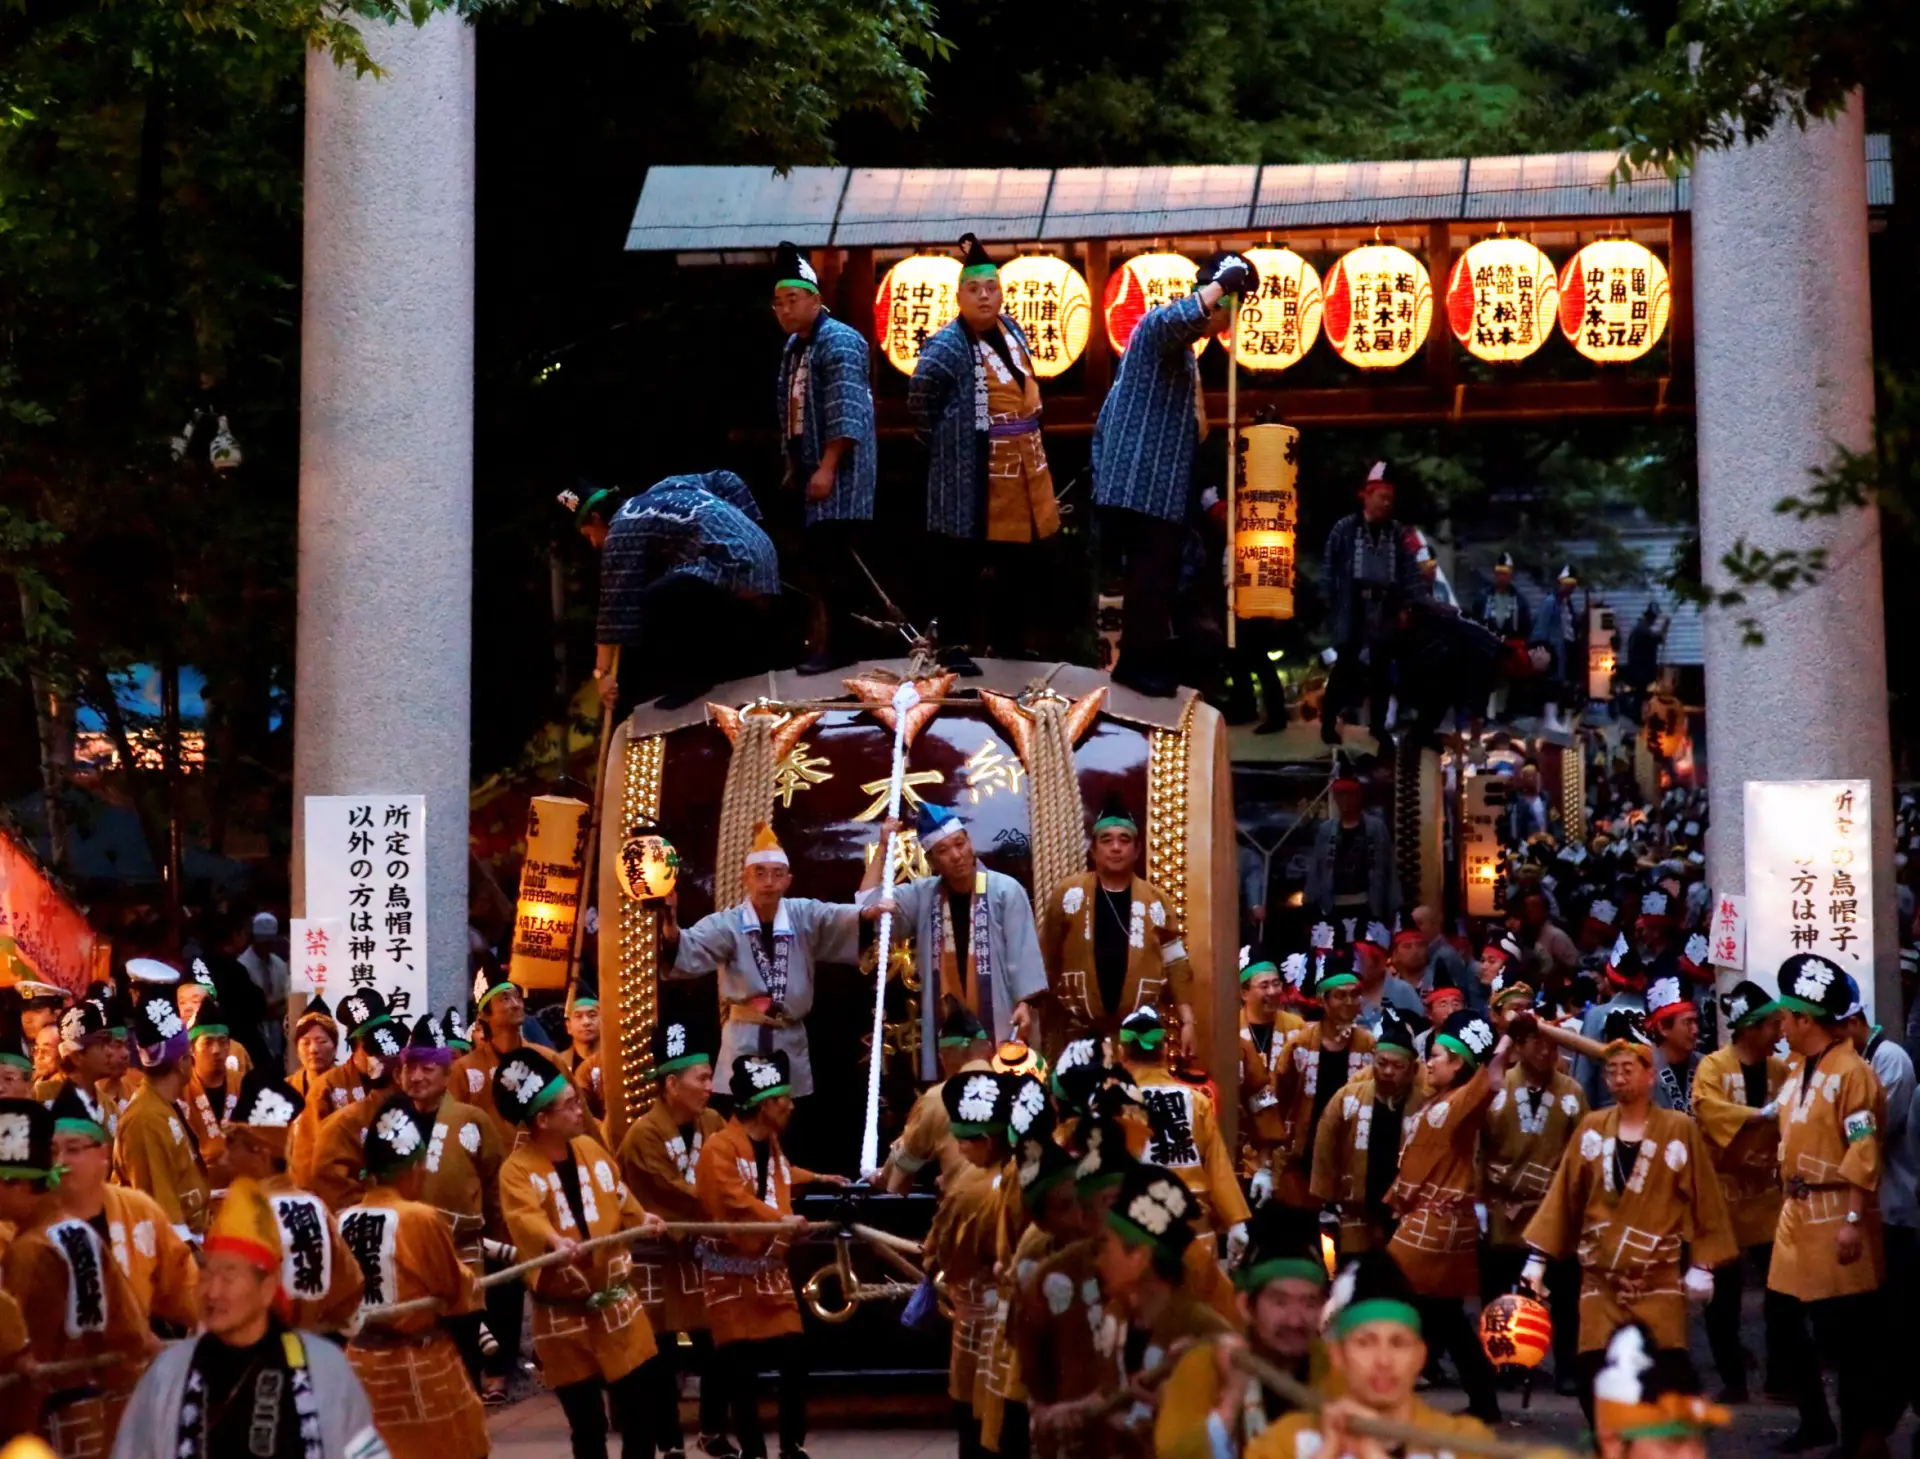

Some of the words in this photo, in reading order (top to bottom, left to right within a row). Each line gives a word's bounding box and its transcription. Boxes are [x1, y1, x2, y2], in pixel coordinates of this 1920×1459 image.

[1041, 281, 1060, 363] 大津本店
[1373, 281, 1395, 351] 青木屋
[1586, 267, 1606, 348] 中久本店
[348, 805, 377, 988] 以外の方は神輿
[1715, 899, 1739, 963] 禁煙
[1790, 856, 1820, 950] 方は神
[772, 936, 789, 1003] 國魂神社
